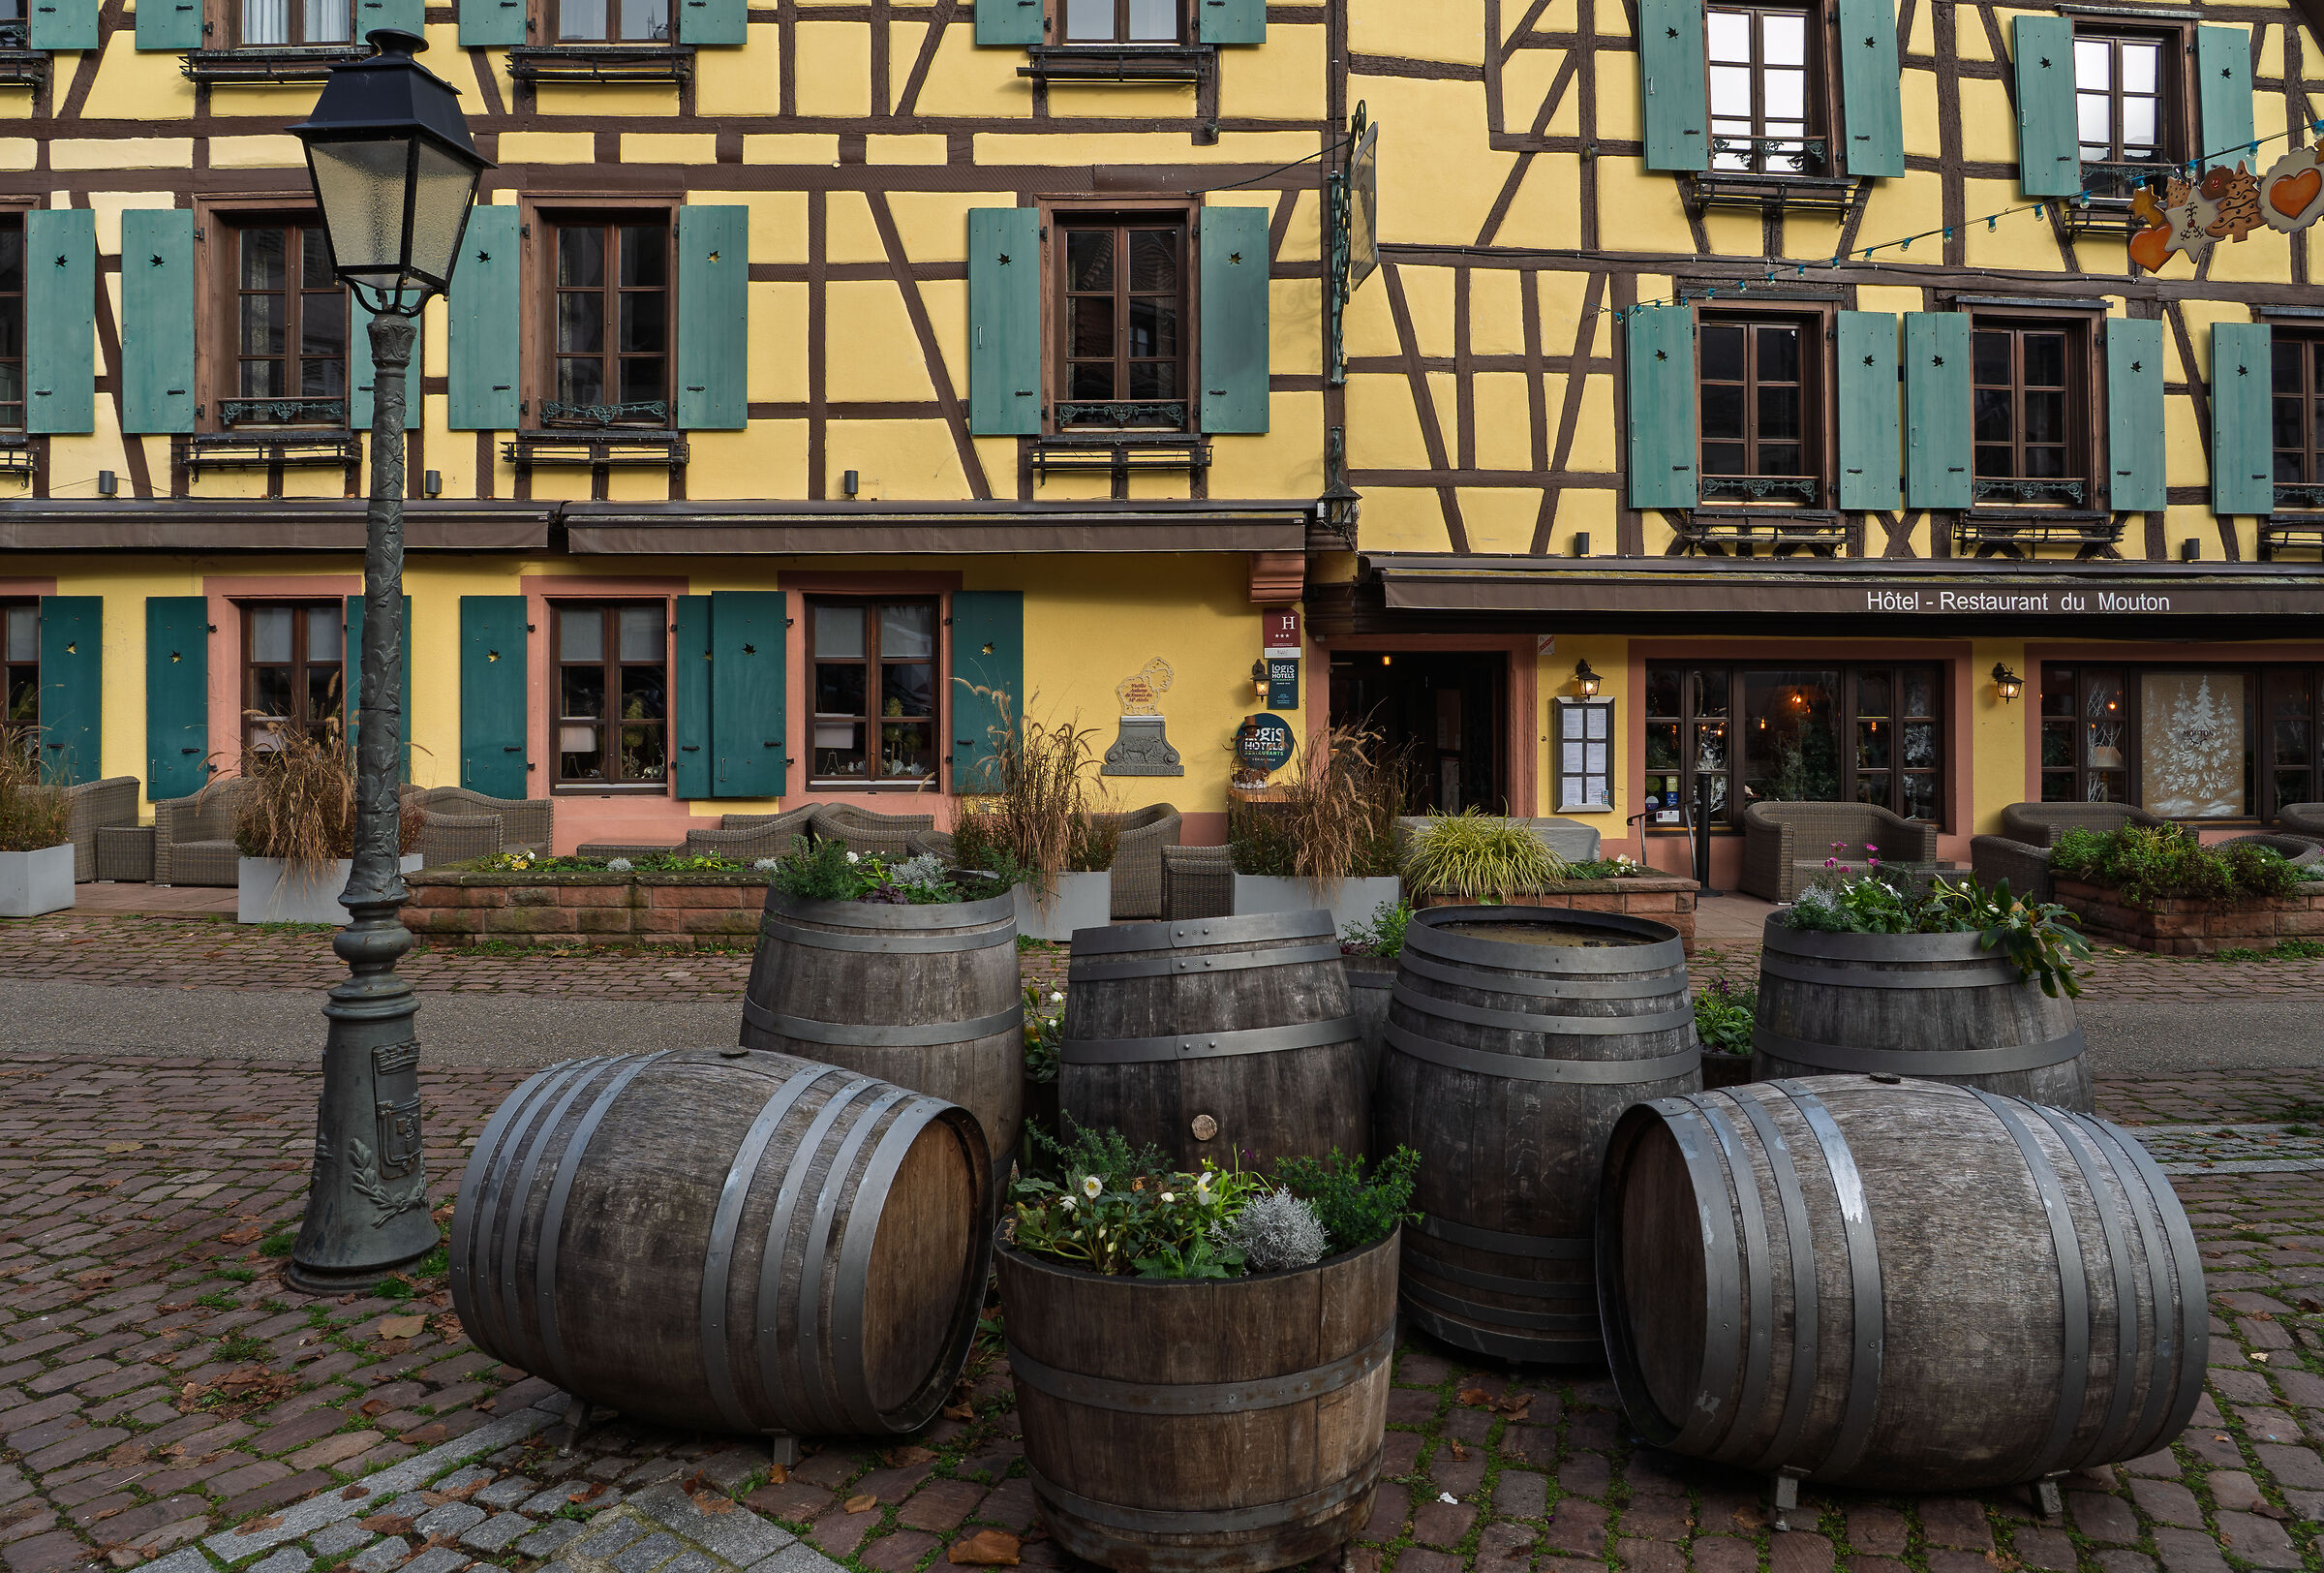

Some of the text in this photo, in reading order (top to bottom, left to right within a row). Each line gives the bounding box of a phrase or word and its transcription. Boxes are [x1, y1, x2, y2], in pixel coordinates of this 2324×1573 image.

[1867, 591, 1919, 610] Hôtel
[1940, 591, 2049, 610] Restaurant
[2061, 592, 2085, 611] du
[2097, 592, 2170, 611] Mouton
[1282, 616, 1296, 630] H
[1271, 663, 1295, 674] Logis
[1244, 727, 1285, 742] gis
